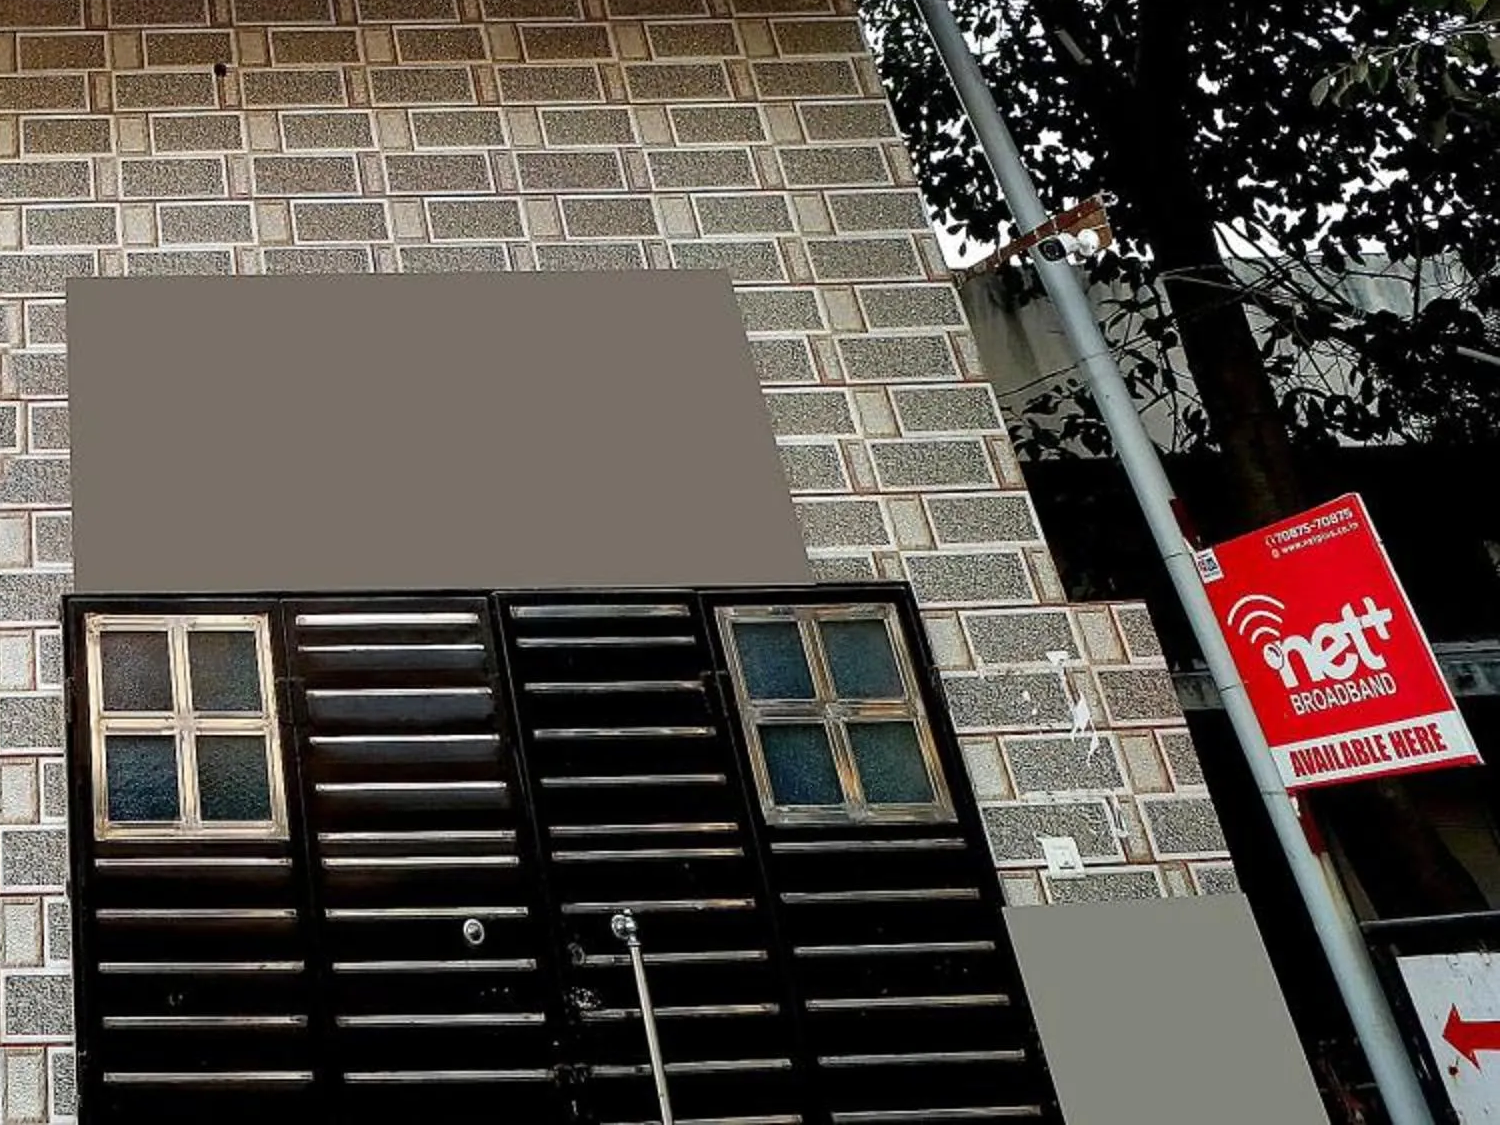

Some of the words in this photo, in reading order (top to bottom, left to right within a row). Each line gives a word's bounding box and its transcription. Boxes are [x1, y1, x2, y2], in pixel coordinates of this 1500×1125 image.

[1289, 672, 1397, 716] BROADBAND
[1289, 733, 1392, 778] AVAILABLE
[1387, 722, 1448, 759] HERE
